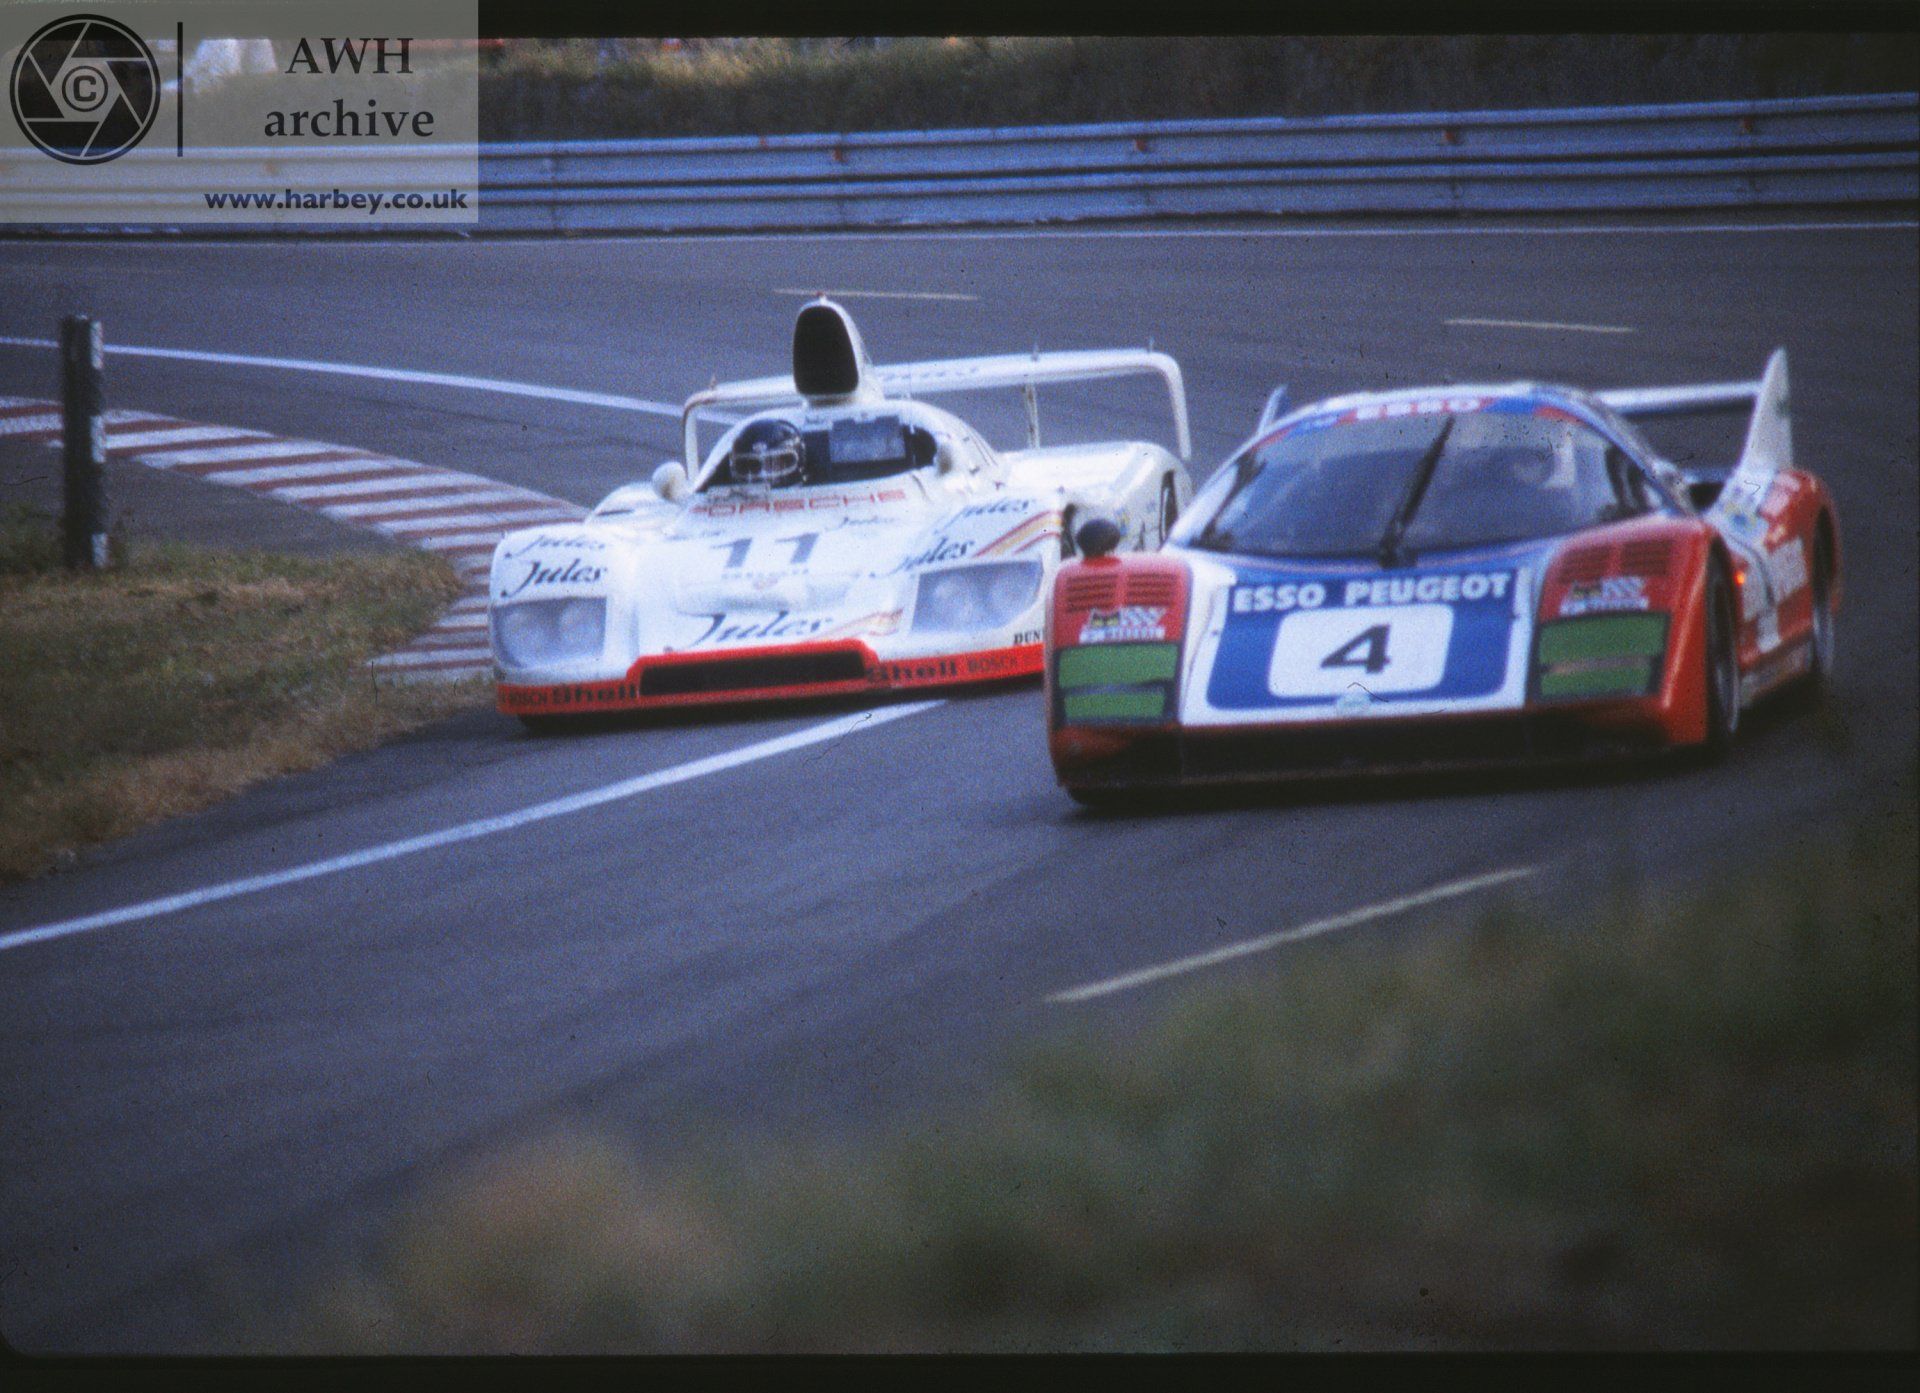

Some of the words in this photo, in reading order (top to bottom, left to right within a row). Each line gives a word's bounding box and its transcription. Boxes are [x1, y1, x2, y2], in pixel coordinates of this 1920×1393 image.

[689, 488, 906, 517] PORSCHE
[710, 532, 819, 569] 11
[499, 558, 608, 598] Jules
[1233, 583, 1326, 613] ESSO
[1345, 571, 1512, 606] PEUGEOT
[1013, 629, 1044, 646] DUN
[1320, 623, 1391, 674] 4
